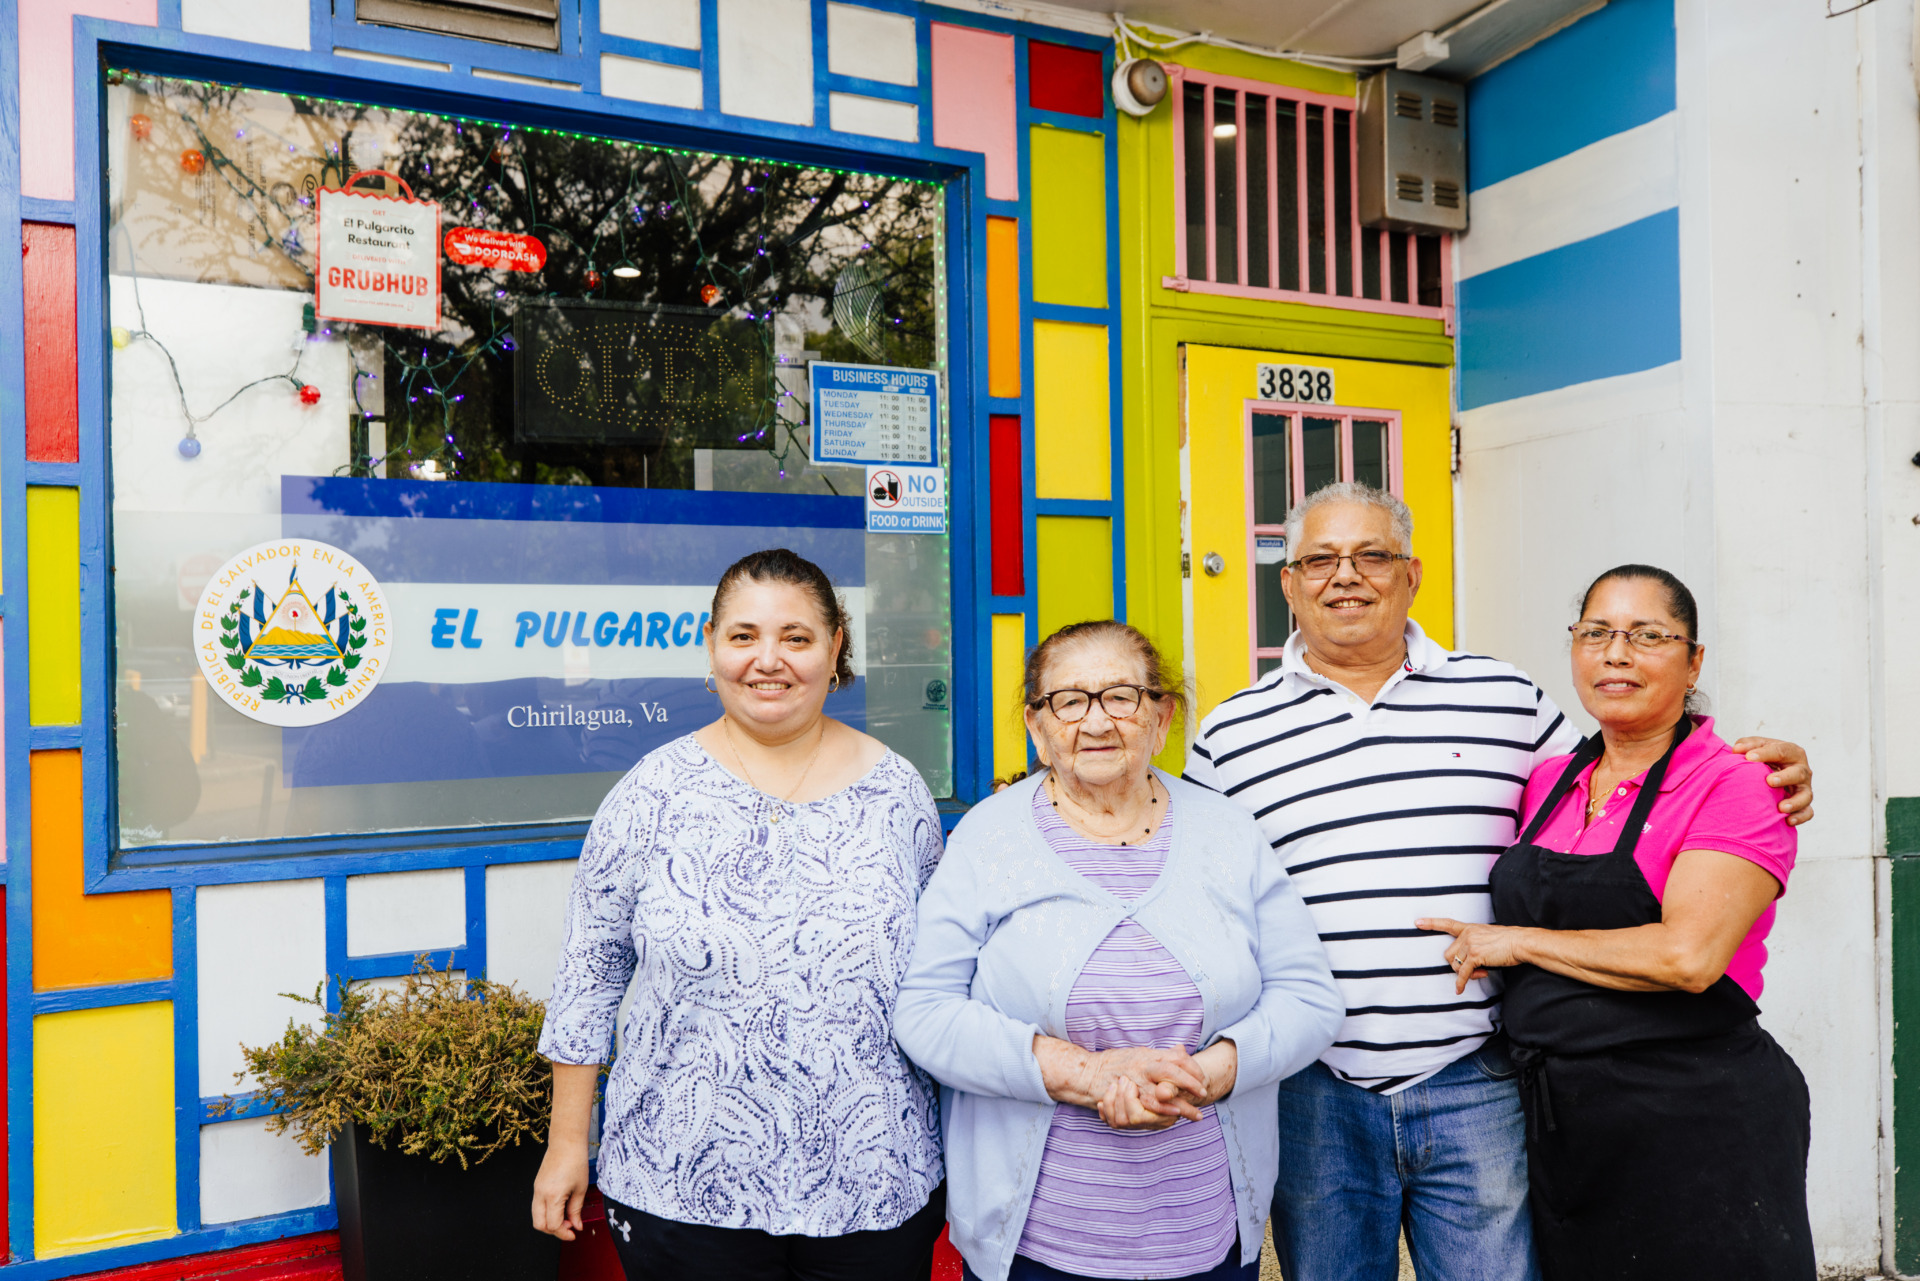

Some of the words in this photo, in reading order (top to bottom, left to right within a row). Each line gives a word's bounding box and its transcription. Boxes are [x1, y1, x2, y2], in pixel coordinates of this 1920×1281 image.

[344, 218, 353, 228] El
[357, 220, 414, 235] Pulgarcito
[348, 234, 410, 249] Restaurant
[464, 234, 478, 242] We
[480, 236, 507, 246] deliver
[475, 247, 538, 262] DOORDASH
[328, 266, 428, 296] GRUBHUB
[536, 346, 756, 404] OPEN
[833, 370, 888, 384] BUSINESS
[891, 374, 928, 388] HOURS
[1260, 367, 1332, 401] 3838
[824, 390, 858, 399] MONDAY
[824, 400, 860, 408] TUESDAY
[824, 410, 873, 419] WEDNESDAY
[824, 420, 866, 428] THURSDAY
[824, 439, 866, 448] SATURDAY
[824, 448, 856, 457] SUNDAY
[908, 475, 937, 494] NO
[902, 497, 943, 508] OUTSIDE
[871, 514, 898, 527] FOOD
[901, 517, 911, 527] or
[912, 516, 943, 528] DRINK
[313, 548, 334, 564] EN
[219, 546, 301, 588] SALVADOR
[337, 560, 354, 577] LA
[208, 592, 224, 606] EL
[201, 611, 215, 630] DE
[358, 582, 386, 647] AMERICA
[431, 608, 483, 648] EL
[514, 611, 709, 650] PULGARCI
[203, 642, 261, 711] REPUBLICA
[327, 658, 379, 710] CENTRAL
[507, 703, 633, 731] Chirilagua,
[639, 702, 668, 723] Va
